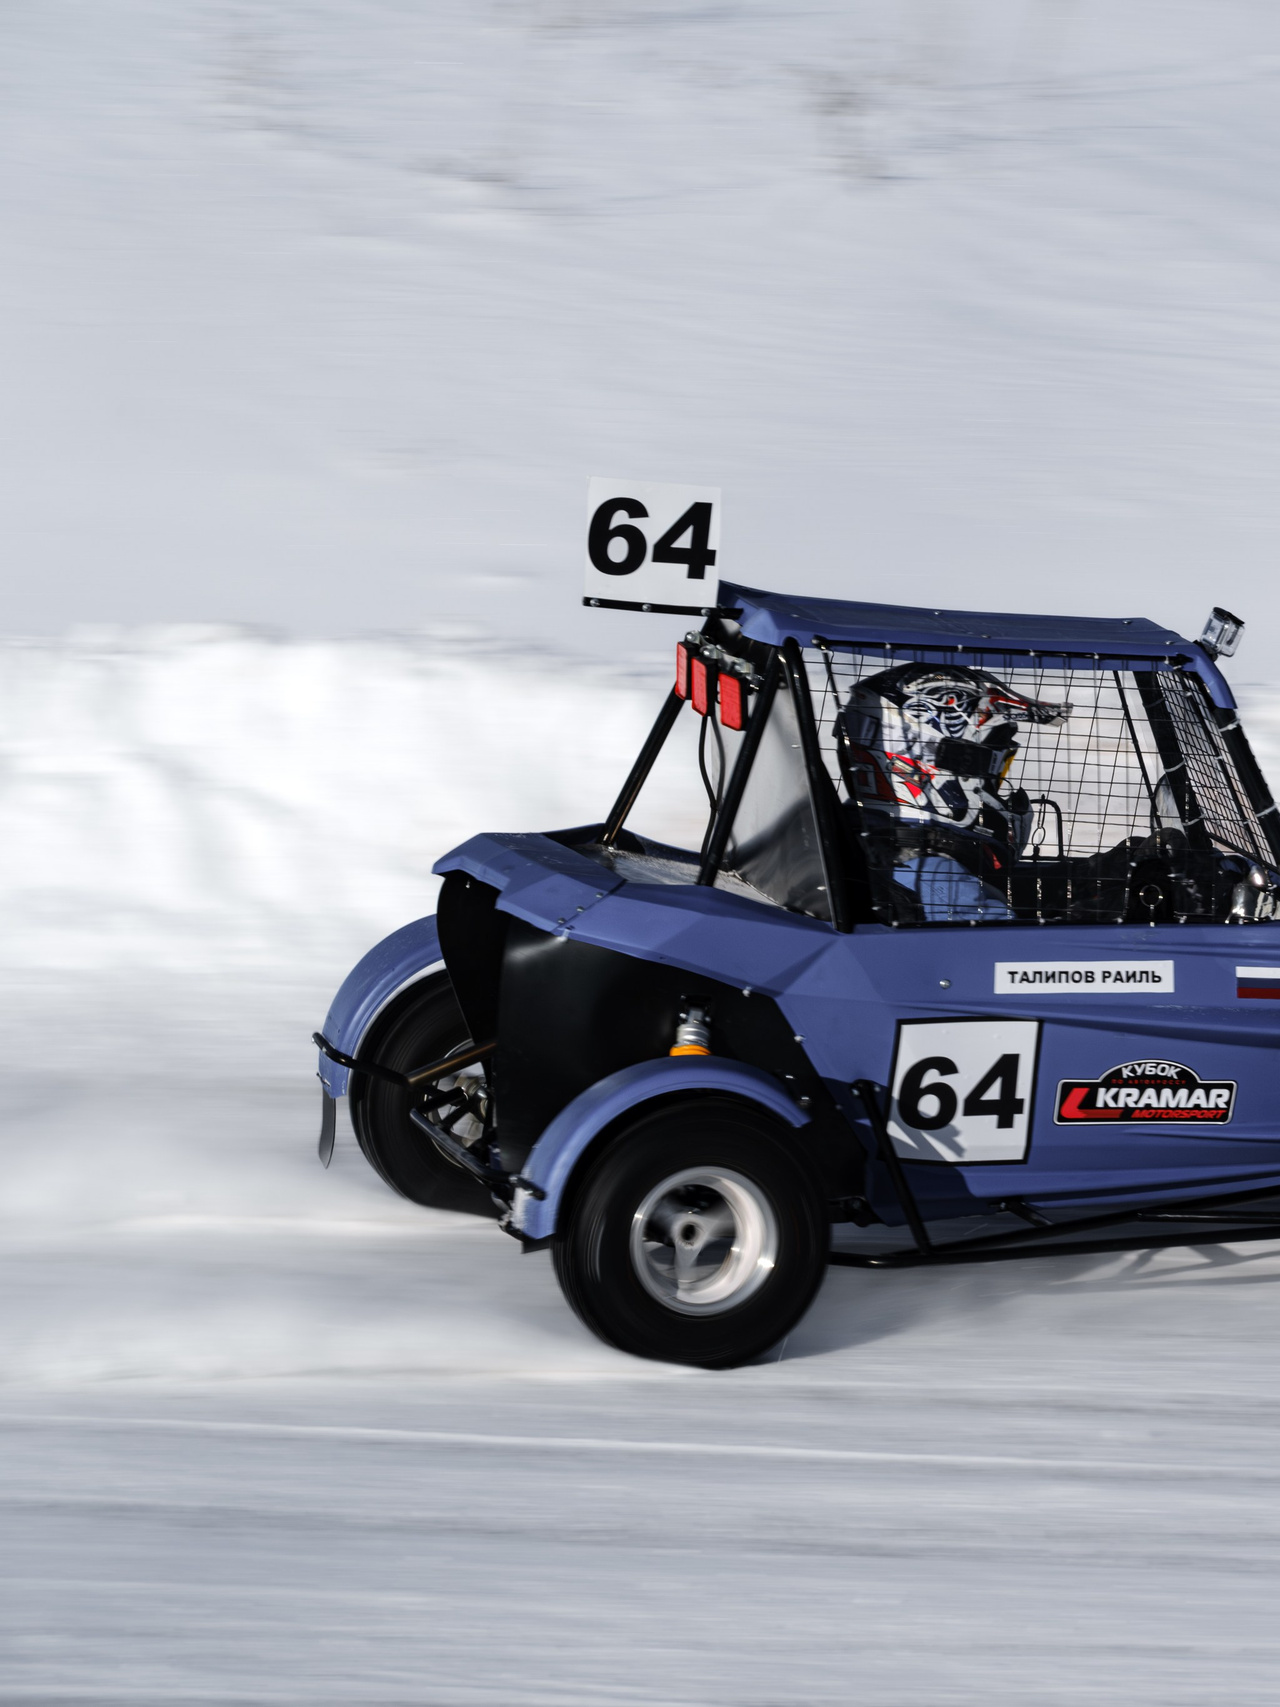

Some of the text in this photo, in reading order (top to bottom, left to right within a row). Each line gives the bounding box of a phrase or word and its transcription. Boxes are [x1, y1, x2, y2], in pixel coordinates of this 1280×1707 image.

[588, 497, 716, 579] 64
[1007, 970, 1162, 984] ТАЛИПОВ РАИЛЬ
[1121, 1063, 1182, 1080] КУБОК
[898, 1053, 1025, 1131] 64
[1095, 1087, 1231, 1109] KRAMAR
[1130, 1109, 1227, 1119] MOTORSPORT
